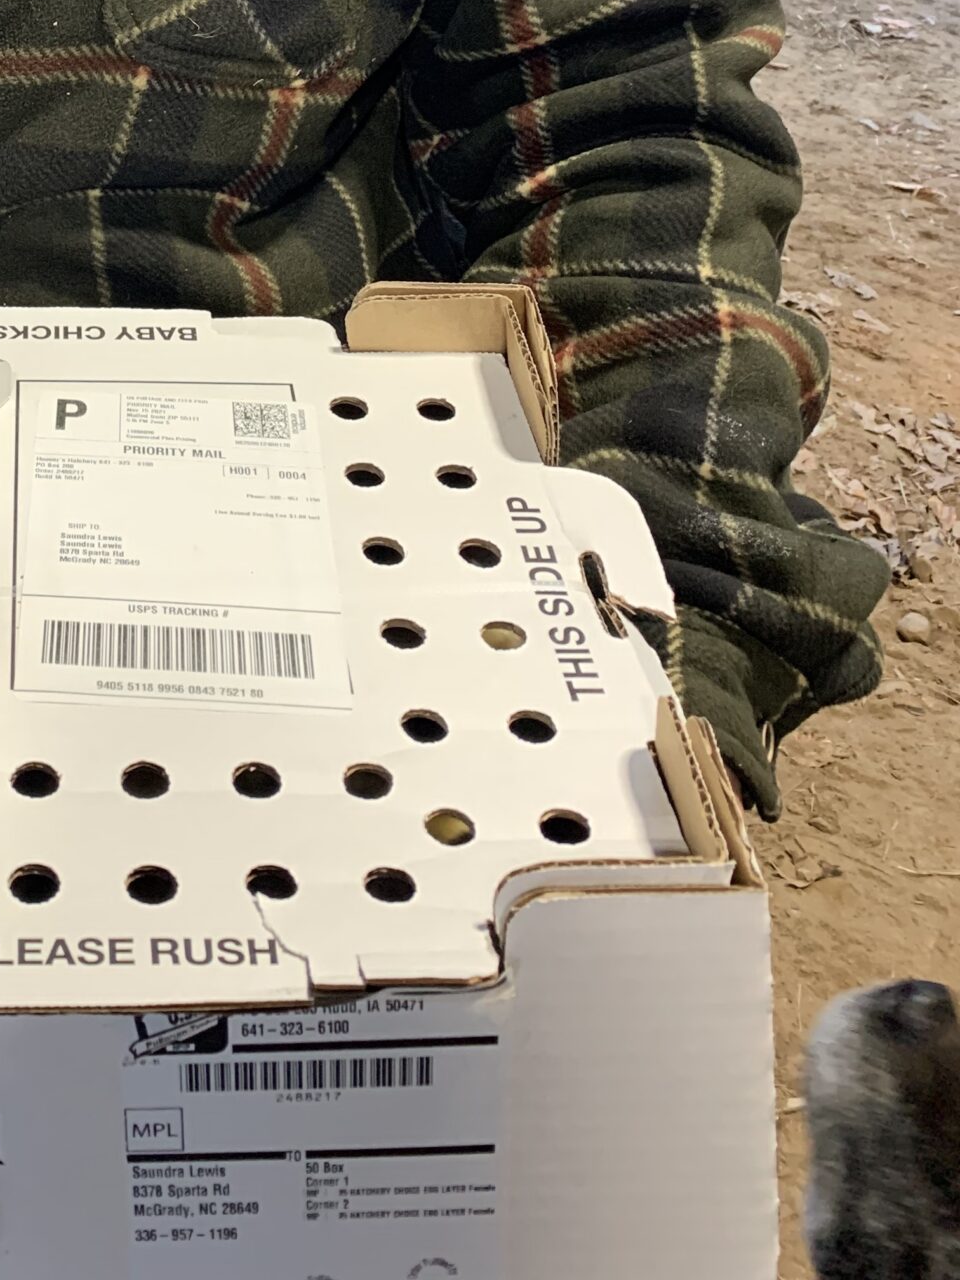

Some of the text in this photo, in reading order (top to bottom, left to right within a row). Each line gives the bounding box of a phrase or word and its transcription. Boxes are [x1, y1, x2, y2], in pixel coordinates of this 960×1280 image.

[116, 326, 198, 341] BABY
[55, 399, 87, 430] P
[123, 445, 227, 459] PRIORITY MAIL
[278, 470, 307, 480] 0004
[60, 532, 122, 542] Saundra Lewis
[60, 540, 95, 548] Saundra
[82, 548, 110, 556] Sparta
[59, 556, 96, 564] McGrady
[506, 496, 605, 702] THIS SIDE UP
[128, 604, 158, 614] USPS
[162, 606, 219, 618] TRACKING
[96, 680, 124, 692] 9405
[127, 682, 154, 692] 5118
[158, 683, 184, 694] 9956
[188, 684, 216, 696] 0843
[219, 686, 246, 698] 7521
[149, 937, 279, 966] RUSH
[367, 999, 380, 1012] IA
[386, 999, 424, 1012] 50471
[132, 1122, 178, 1138] MPL
[286, 1150, 302, 1162] TO
[132, 1164, 226, 1179] Saundra Lewis
[305, 1162, 344, 1173] 50 Box
[306, 1176, 350, 1188] Corner 1
[132, 1183, 230, 1199] 8378 Sparta Rd
[134, 1202, 260, 1218] McGrady, NC 28649
[306, 1199, 350, 1210] Corner 2
